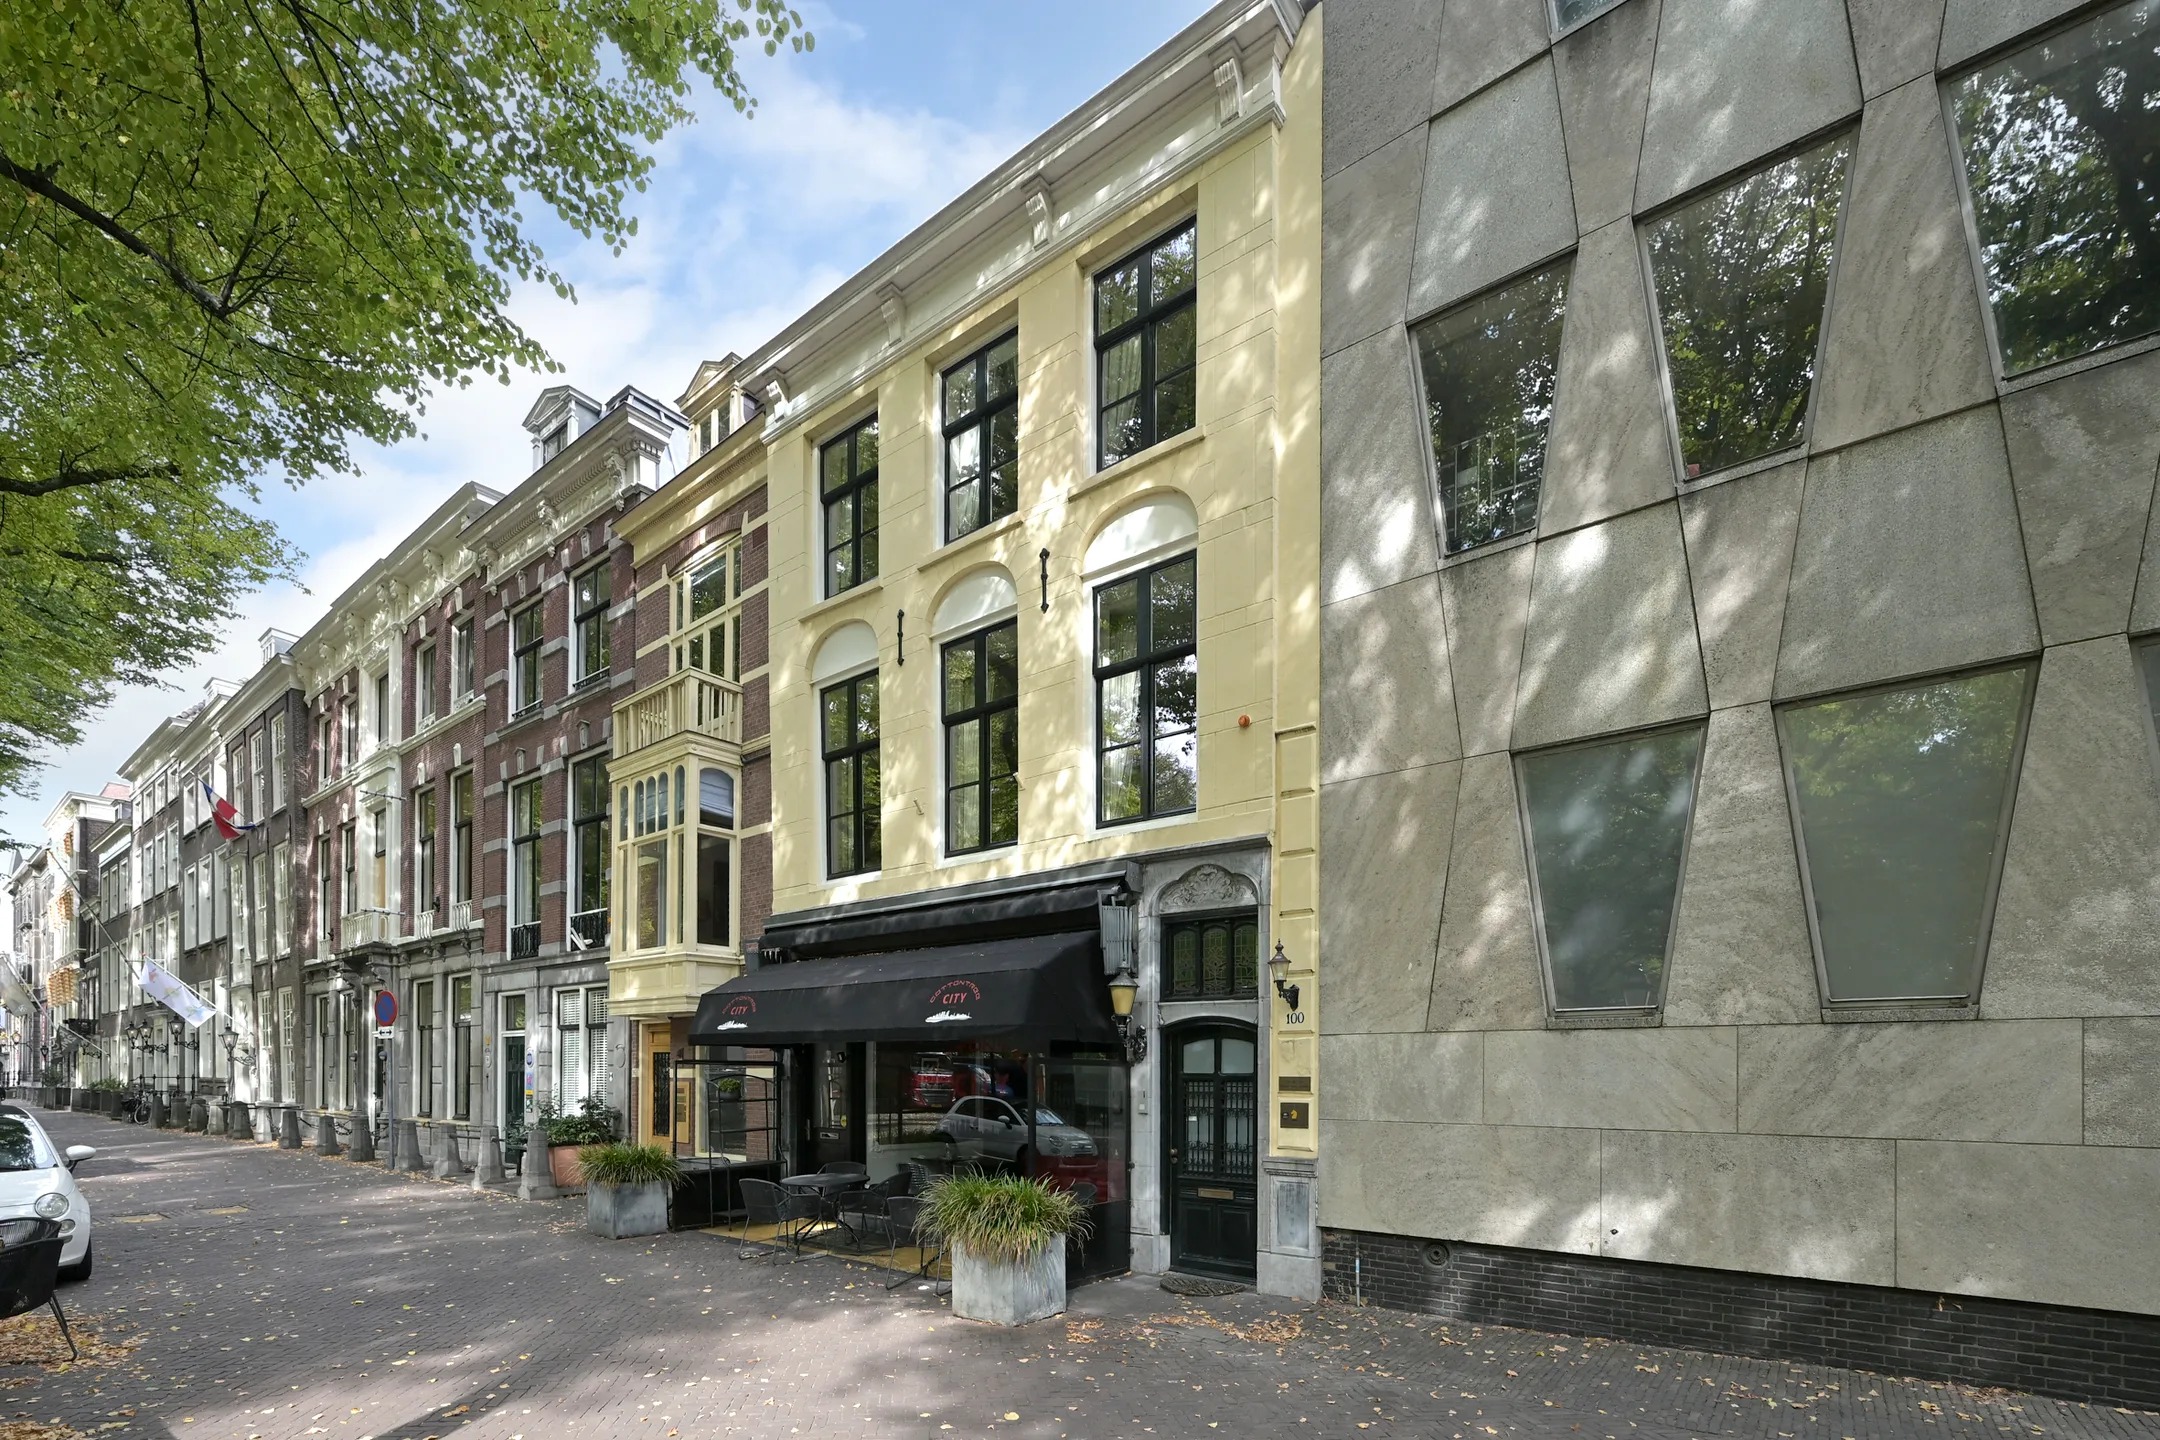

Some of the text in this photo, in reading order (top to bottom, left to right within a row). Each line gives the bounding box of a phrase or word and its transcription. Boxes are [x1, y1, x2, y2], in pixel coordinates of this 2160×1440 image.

[943, 992, 967, 1004] CITY
[730, 1006, 748, 1015] CITY
[1286, 1012, 1304, 1024] 100
